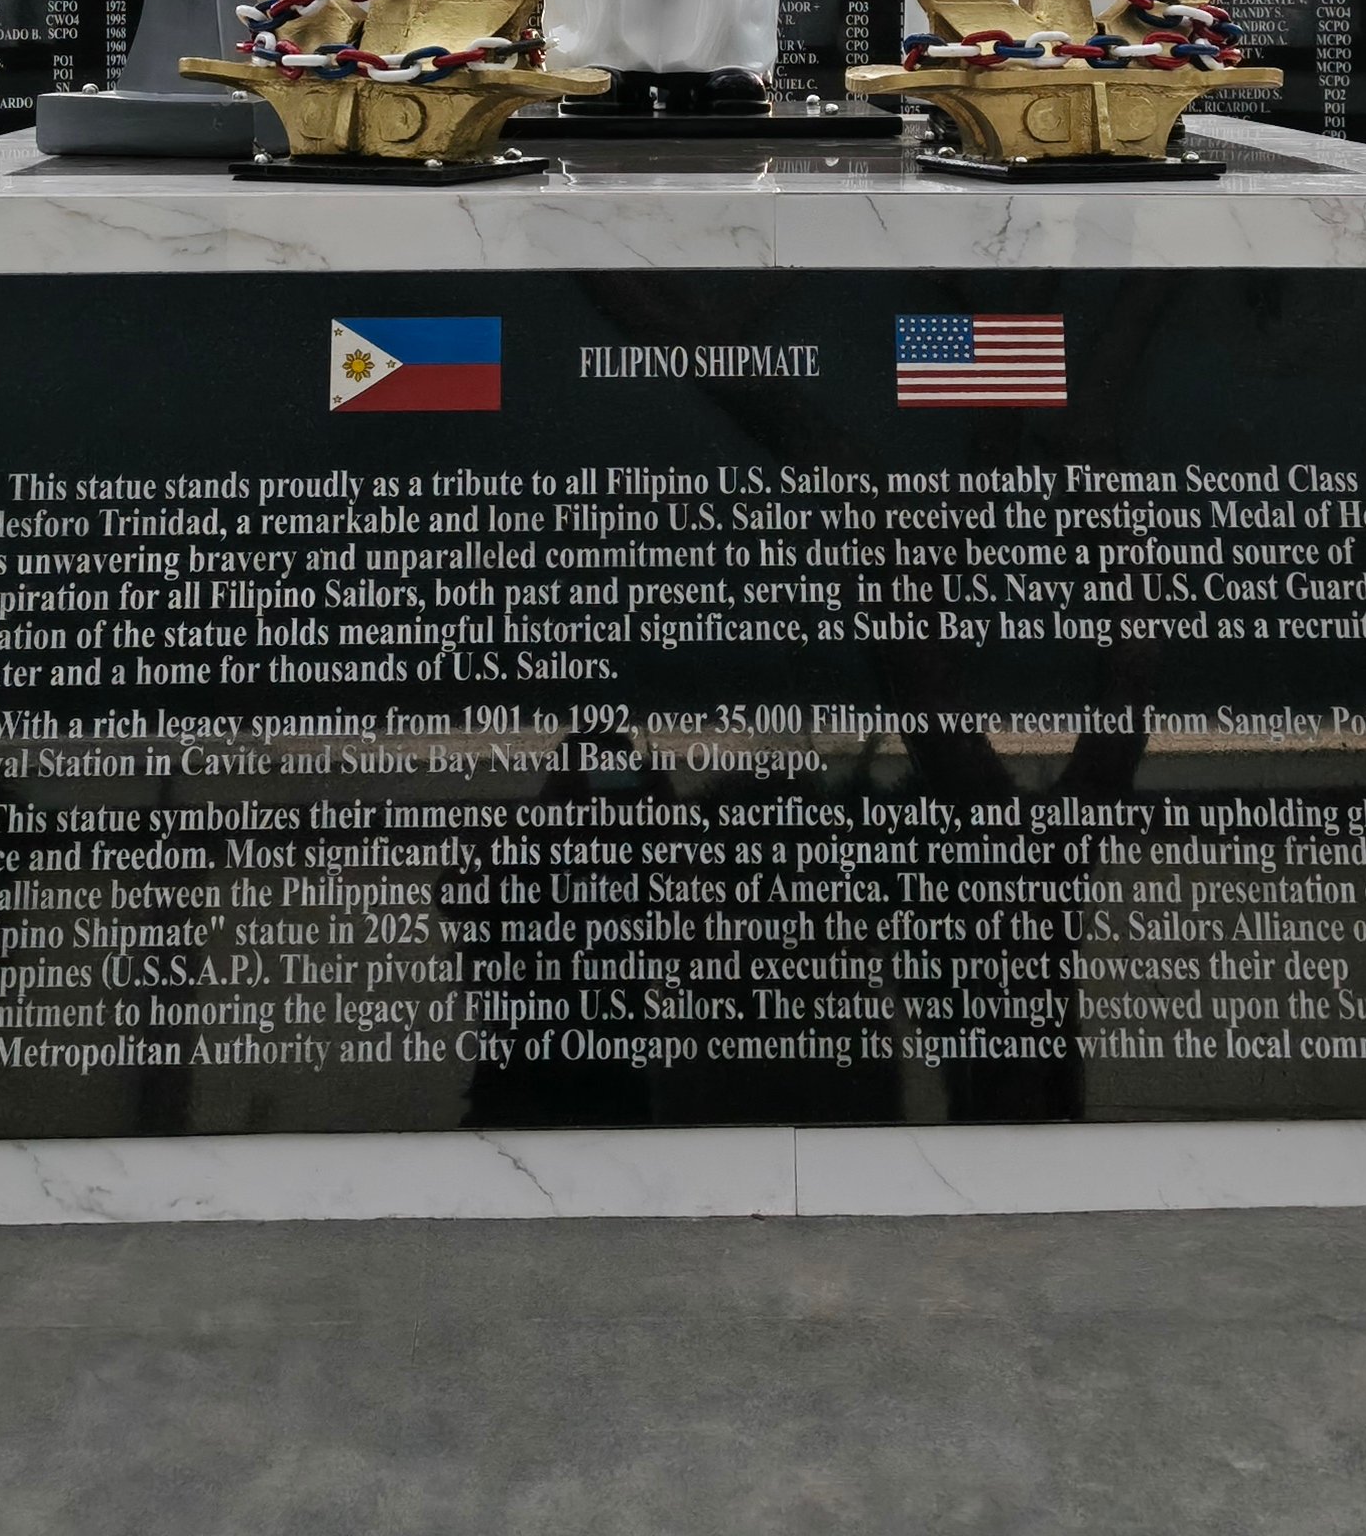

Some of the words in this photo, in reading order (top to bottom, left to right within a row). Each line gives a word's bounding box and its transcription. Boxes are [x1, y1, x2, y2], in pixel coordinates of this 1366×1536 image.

[579, 345, 688, 378] FILIPINO
[694, 345, 820, 377] SHIPMATE
[8, 473, 67, 500] This
[76, 475, 157, 500] statue
[164, 471, 250, 499] stands
[259, 471, 365, 506] proudly
[372, 478, 400, 497] as
[408, 477, 423, 496] a
[432, 469, 523, 496] tribute
[531, 471, 557, 495] to
[565, 468, 598, 494] all
[606, 467, 709, 502] Filipino
[717, 466, 772, 494] U.S.
[780, 466, 879, 498] Sailors,
[887, 469, 950, 493] most
[958, 466, 1057, 500] notably
[1065, 465, 1178, 492] Fireman
[1185, 465, 1280, 492] Second
[1288, 465, 1359, 492] Class
[99, 508, 227, 540] Trinidad,
[236, 515, 251, 534] a
[261, 506, 420, 534] remarkable
[429, 505, 479, 532] and
[488, 505, 545, 532] lone
[554, 504, 659, 539] Filipino
[668, 503, 723, 530] U.S.
[732, 502, 813, 530] Sailor
[820, 502, 876, 529] who
[885, 502, 997, 529] received
[1004, 501, 1047, 528] the
[1054, 501, 1202, 536] prestigious
[1208, 501, 1297, 528] Medal
[1304, 500, 1332, 528] of
[68, 718, 84, 738] a
[92, 710, 148, 738] rich
[157, 709, 244, 746] legacy
[251, 707, 377, 744] spanning
[385, 707, 451, 735] from
[463, 705, 520, 734] 1901
[532, 708, 559, 733] to
[568, 704, 639, 739] 1992,
[647, 714, 708, 740] over
[715, 704, 802, 737] 35,000
[810, 705, 929, 741] Filipinos
[937, 713, 1002, 733] were
[1010, 705, 1135, 734] recruited
[1142, 705, 1207, 733] from
[1217, 706, 1323, 744] Sangley
[37, 748, 135, 777] Station
[145, 747, 172, 775] in
[181, 746, 271, 775] Cavite
[280, 745, 331, 774] and
[340, 745, 418, 773] Subic
[426, 746, 478, 780] Bay
[489, 743, 570, 772] Naval
[578, 743, 643, 771] Base
[650, 743, 677, 770] in
[686, 743, 828, 779] Olongapo.
[188, 1034, 332, 1071] Authority
[340, 1032, 392, 1062] and
[402, 1032, 446, 1061] the
[455, 1031, 516, 1069] City
[524, 1030, 556, 1060] of
[560, 1029, 698, 1068] Olongapo
[707, 1031, 852, 1067] cementing
[861, 1031, 893, 1058] its
[902, 1027, 1067, 1067] significance
[1074, 1028, 1165, 1058] within
[1173, 1028, 1217, 1058] the
[1225, 1029, 1292, 1058] local
